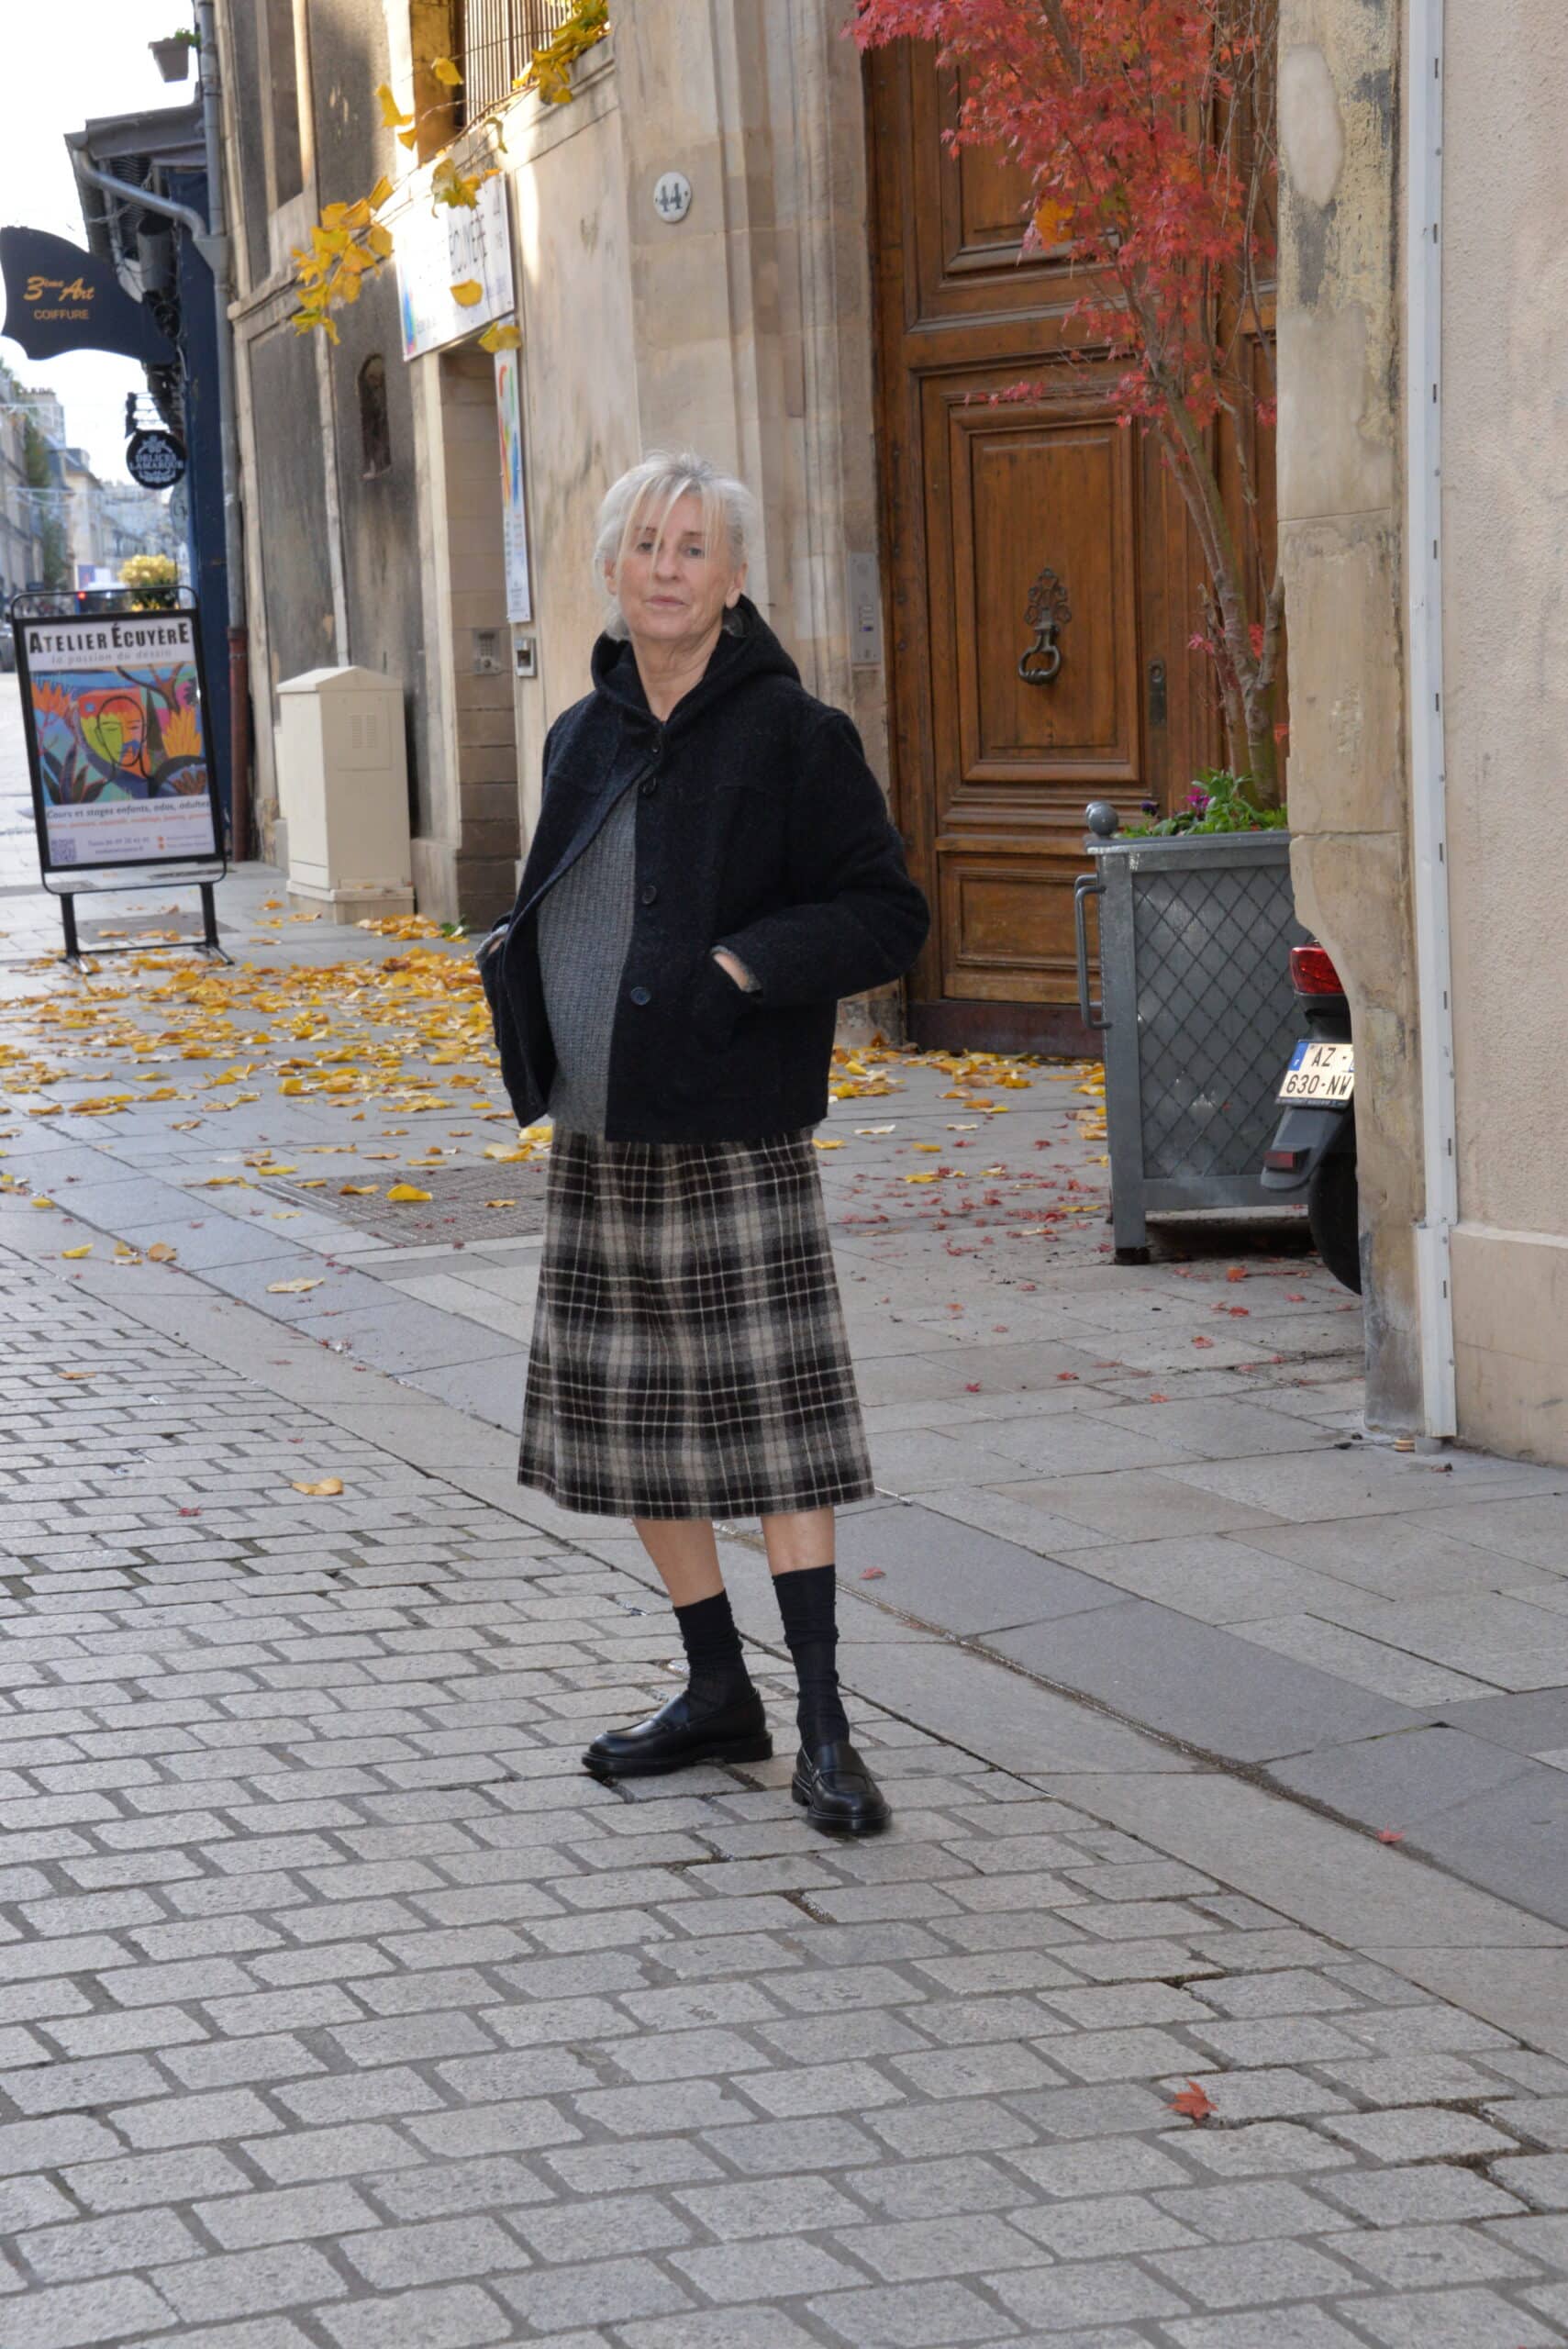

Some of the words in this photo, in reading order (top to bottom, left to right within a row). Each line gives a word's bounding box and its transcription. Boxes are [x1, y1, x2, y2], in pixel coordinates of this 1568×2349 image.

[660, 183, 683, 212] 44
[59, 277, 95, 302] Art
[34, 308, 90, 320] COIFFURE
[28, 631, 107, 654] ATELIER
[74, 809, 83, 818] et
[1286, 1074, 1351, 1096] 630-NW
